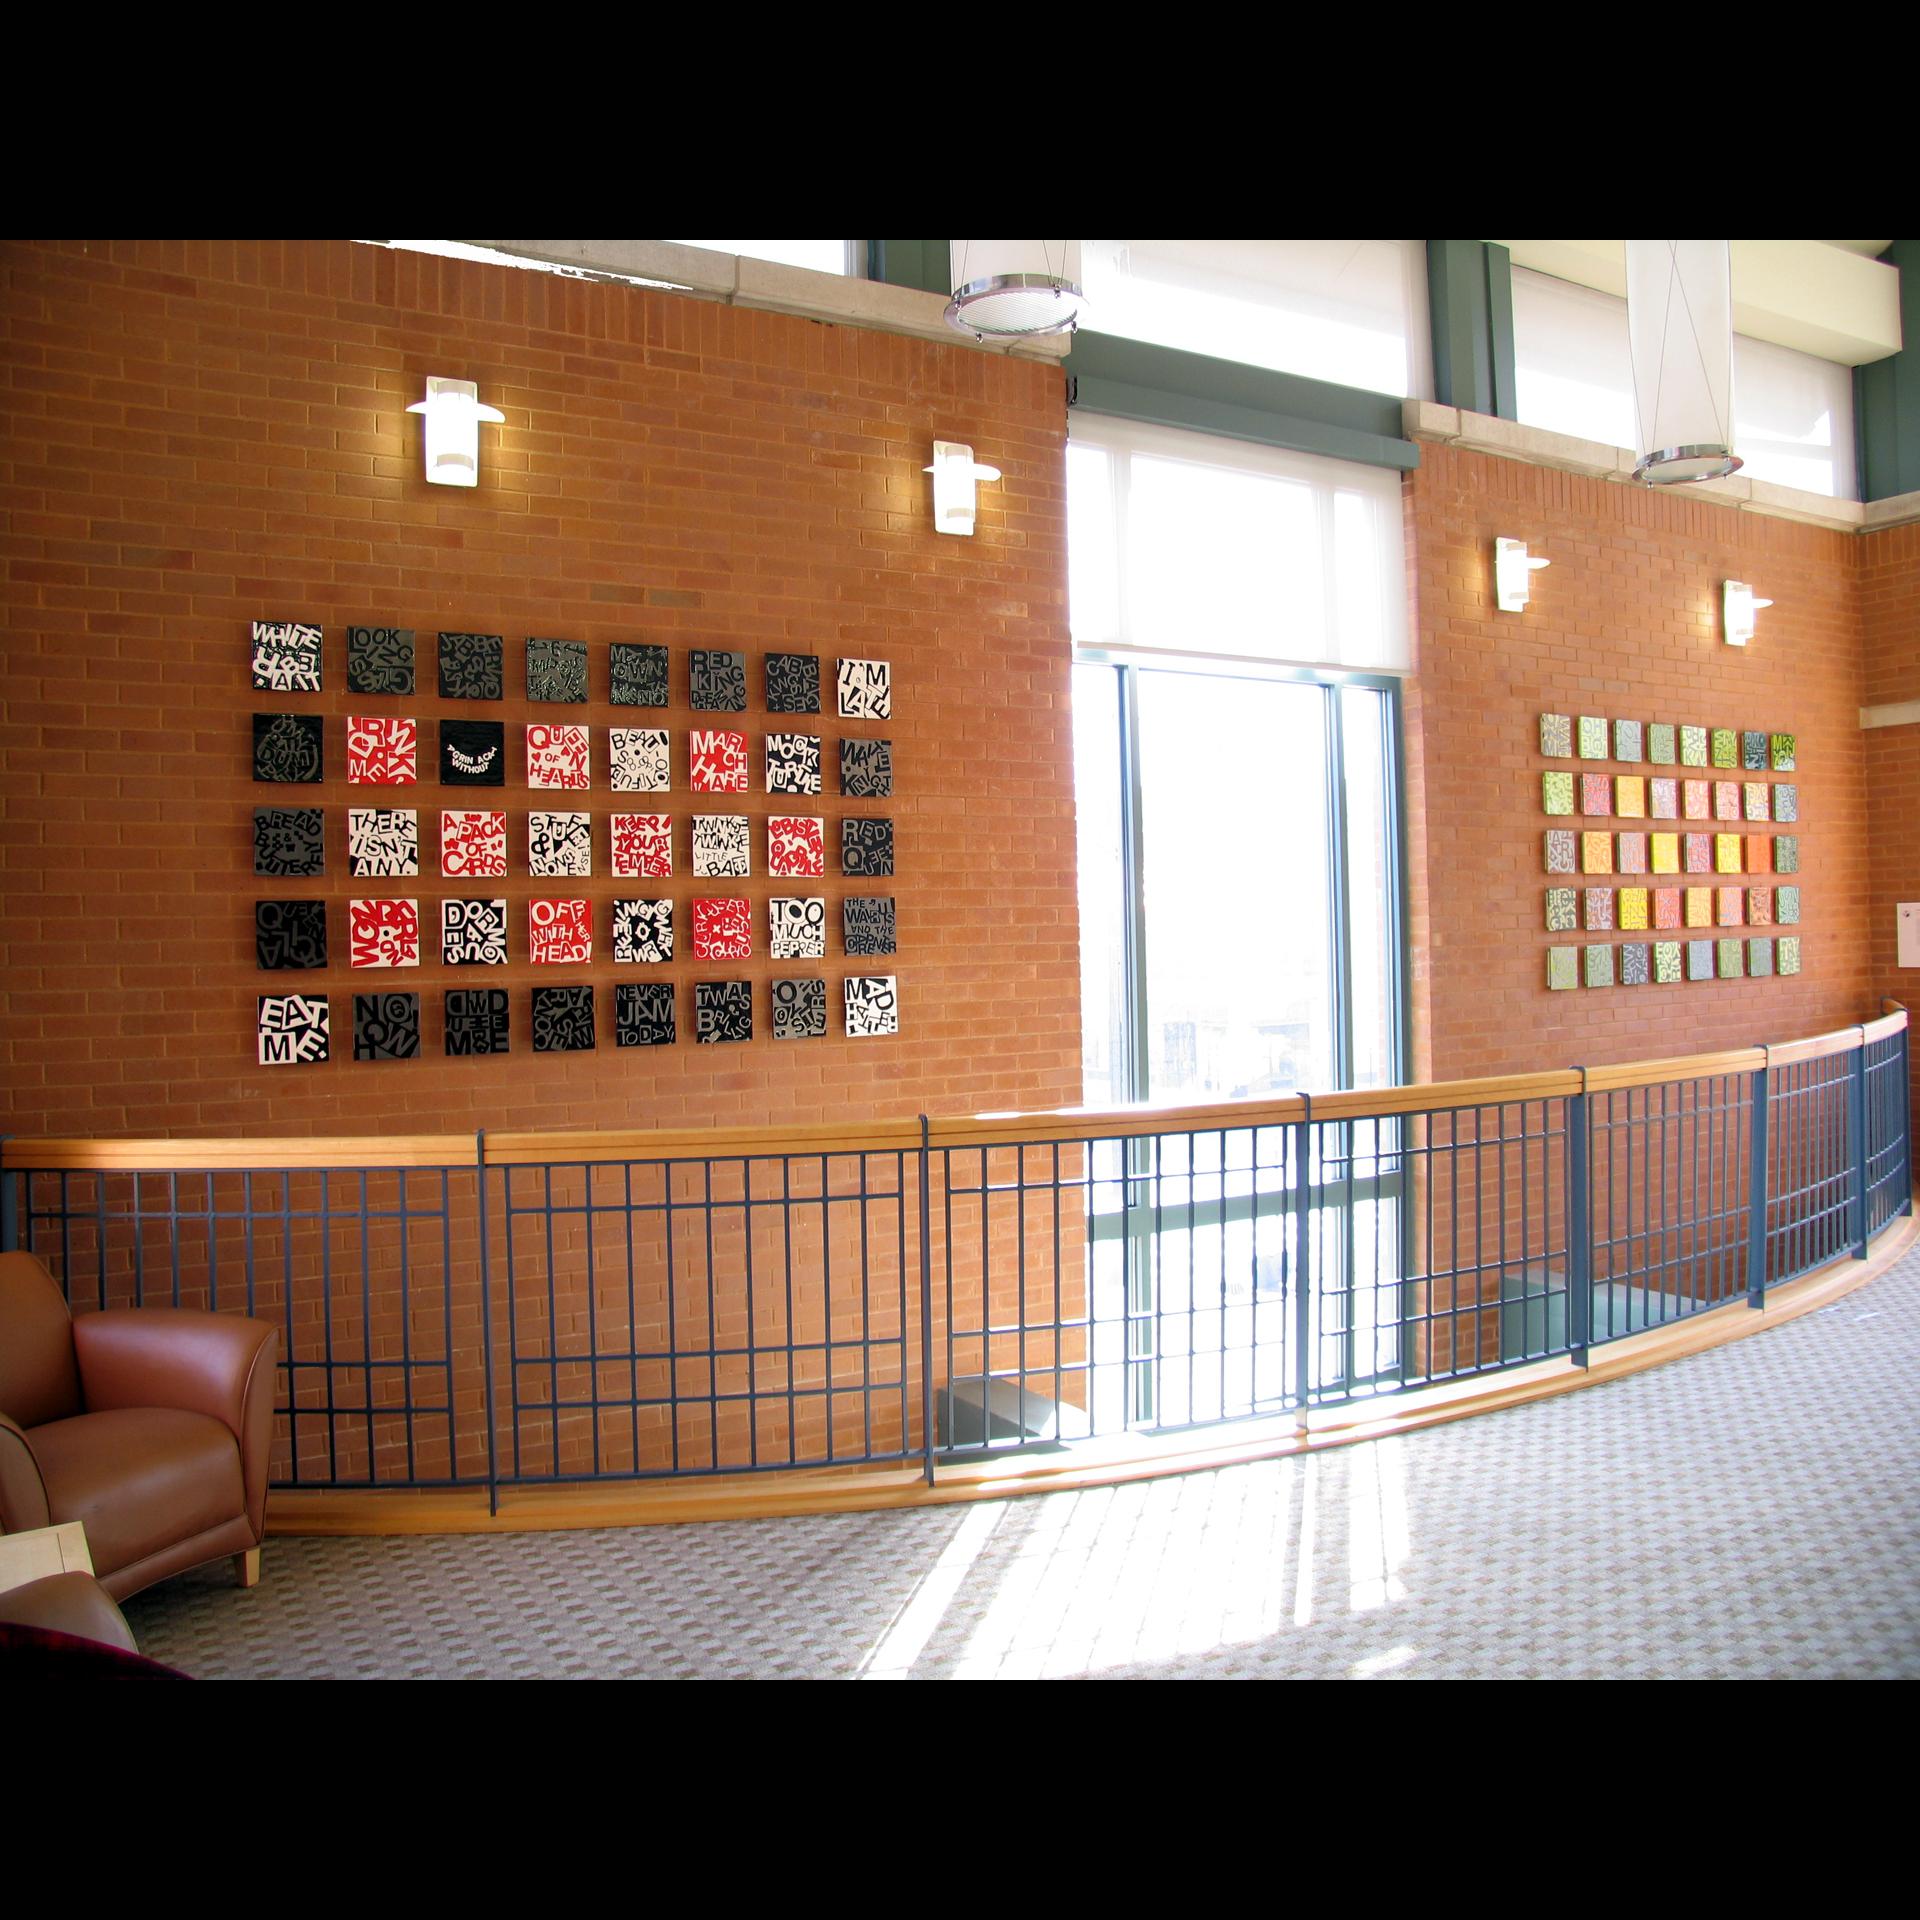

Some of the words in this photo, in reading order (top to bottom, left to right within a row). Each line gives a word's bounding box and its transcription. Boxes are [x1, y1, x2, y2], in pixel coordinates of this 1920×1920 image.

[253, 622, 322, 649] WHITE
[253, 647, 320, 691] RABBIT
[691, 651, 733, 672] RED
[842, 661, 886, 686] I'M
[697, 666, 744, 691] KING
[840, 685, 890, 719] LATE
[350, 719, 416, 780] DRINK
[452, 751, 473, 764] GRIN
[528, 726, 589, 771] QUEEN
[545, 753, 560, 762] OF
[692, 731, 747, 773] MARCH
[767, 735, 819, 766] MOCK
[841, 741, 891, 772] WHITE
[350, 760, 386, 782] ME
[452, 759, 490, 774] WITHOUT
[530, 762, 590, 789] HEARTS
[692, 755, 748, 792] HARE
[767, 758, 821, 794] TURTLE
[841, 767, 891, 796] KNIGHT
[256, 811, 321, 836] BREAD
[350, 812, 416, 838] THERE
[444, 814, 457, 832] A
[456, 813, 505, 842] PACK
[530, 814, 590, 846] STUFF
[614, 815, 660, 834] KEEP
[692, 816, 749, 833] TWINKLE
[842, 819, 887, 842] RED
[466, 842, 487, 856] OF
[531, 833, 550, 858] &
[613, 833, 671, 854] YOUR
[694, 832, 749, 853] TWINKLE
[768, 818, 823, 860] LOBSTER
[443, 851, 506, 877] CARDS
[614, 852, 672, 876] TEMPER
[694, 852, 727, 862] LITTLE
[706, 856, 748, 876] BAT
[842, 847, 894, 875] QUEEN
[532, 900, 586, 925] OFF
[771, 899, 823, 925] TOO
[846, 903, 895, 925] WALRUS
[847, 899, 865, 908] THE
[352, 900, 418, 967] WONDERLAND
[445, 901, 508, 964] DORMOUSE
[532, 924, 572, 945] WITH
[576, 921, 590, 942] HER
[772, 924, 824, 941] MUCH
[851, 925, 870, 934] AND
[875, 926, 894, 934] THE
[532, 941, 592, 963] HEAD!
[772, 941, 825, 956] PEPPER
[616, 985, 673, 1001] NEVER
[846, 978, 894, 1010] MAD
[260, 995, 328, 1030] EAT
[616, 999, 674, 1026] JAM
[698, 1009, 752, 1039] BRILLIG
[846, 1002, 898, 1033] HATTER
